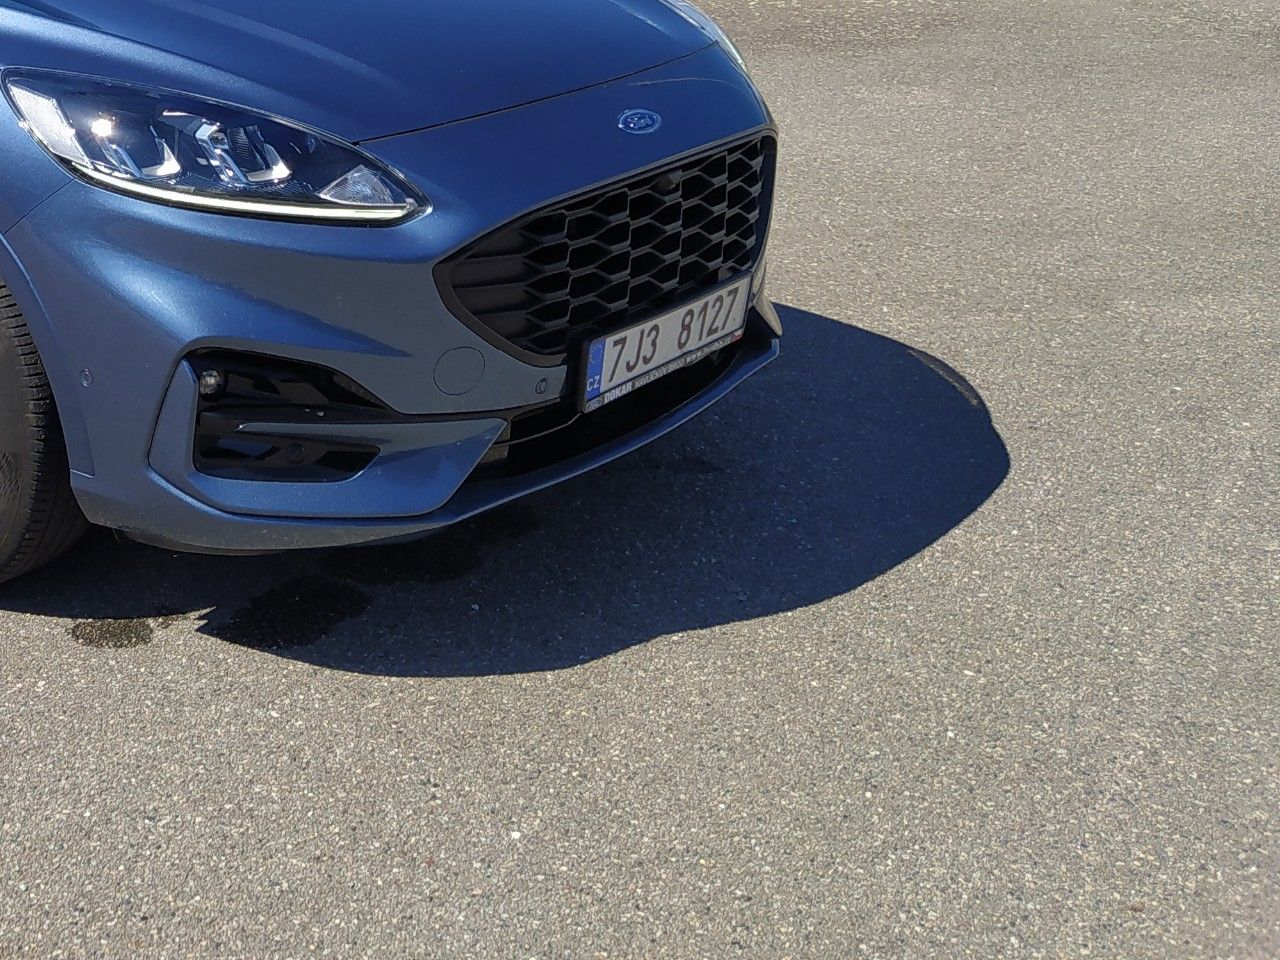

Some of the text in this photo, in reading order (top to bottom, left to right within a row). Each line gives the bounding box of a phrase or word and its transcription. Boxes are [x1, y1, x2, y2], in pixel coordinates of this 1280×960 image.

[609, 324, 660, 383] 7J3
[677, 286, 739, 350] 8127
[586, 374, 600, 392] CZ
[604, 381, 633, 405] DOKAR
